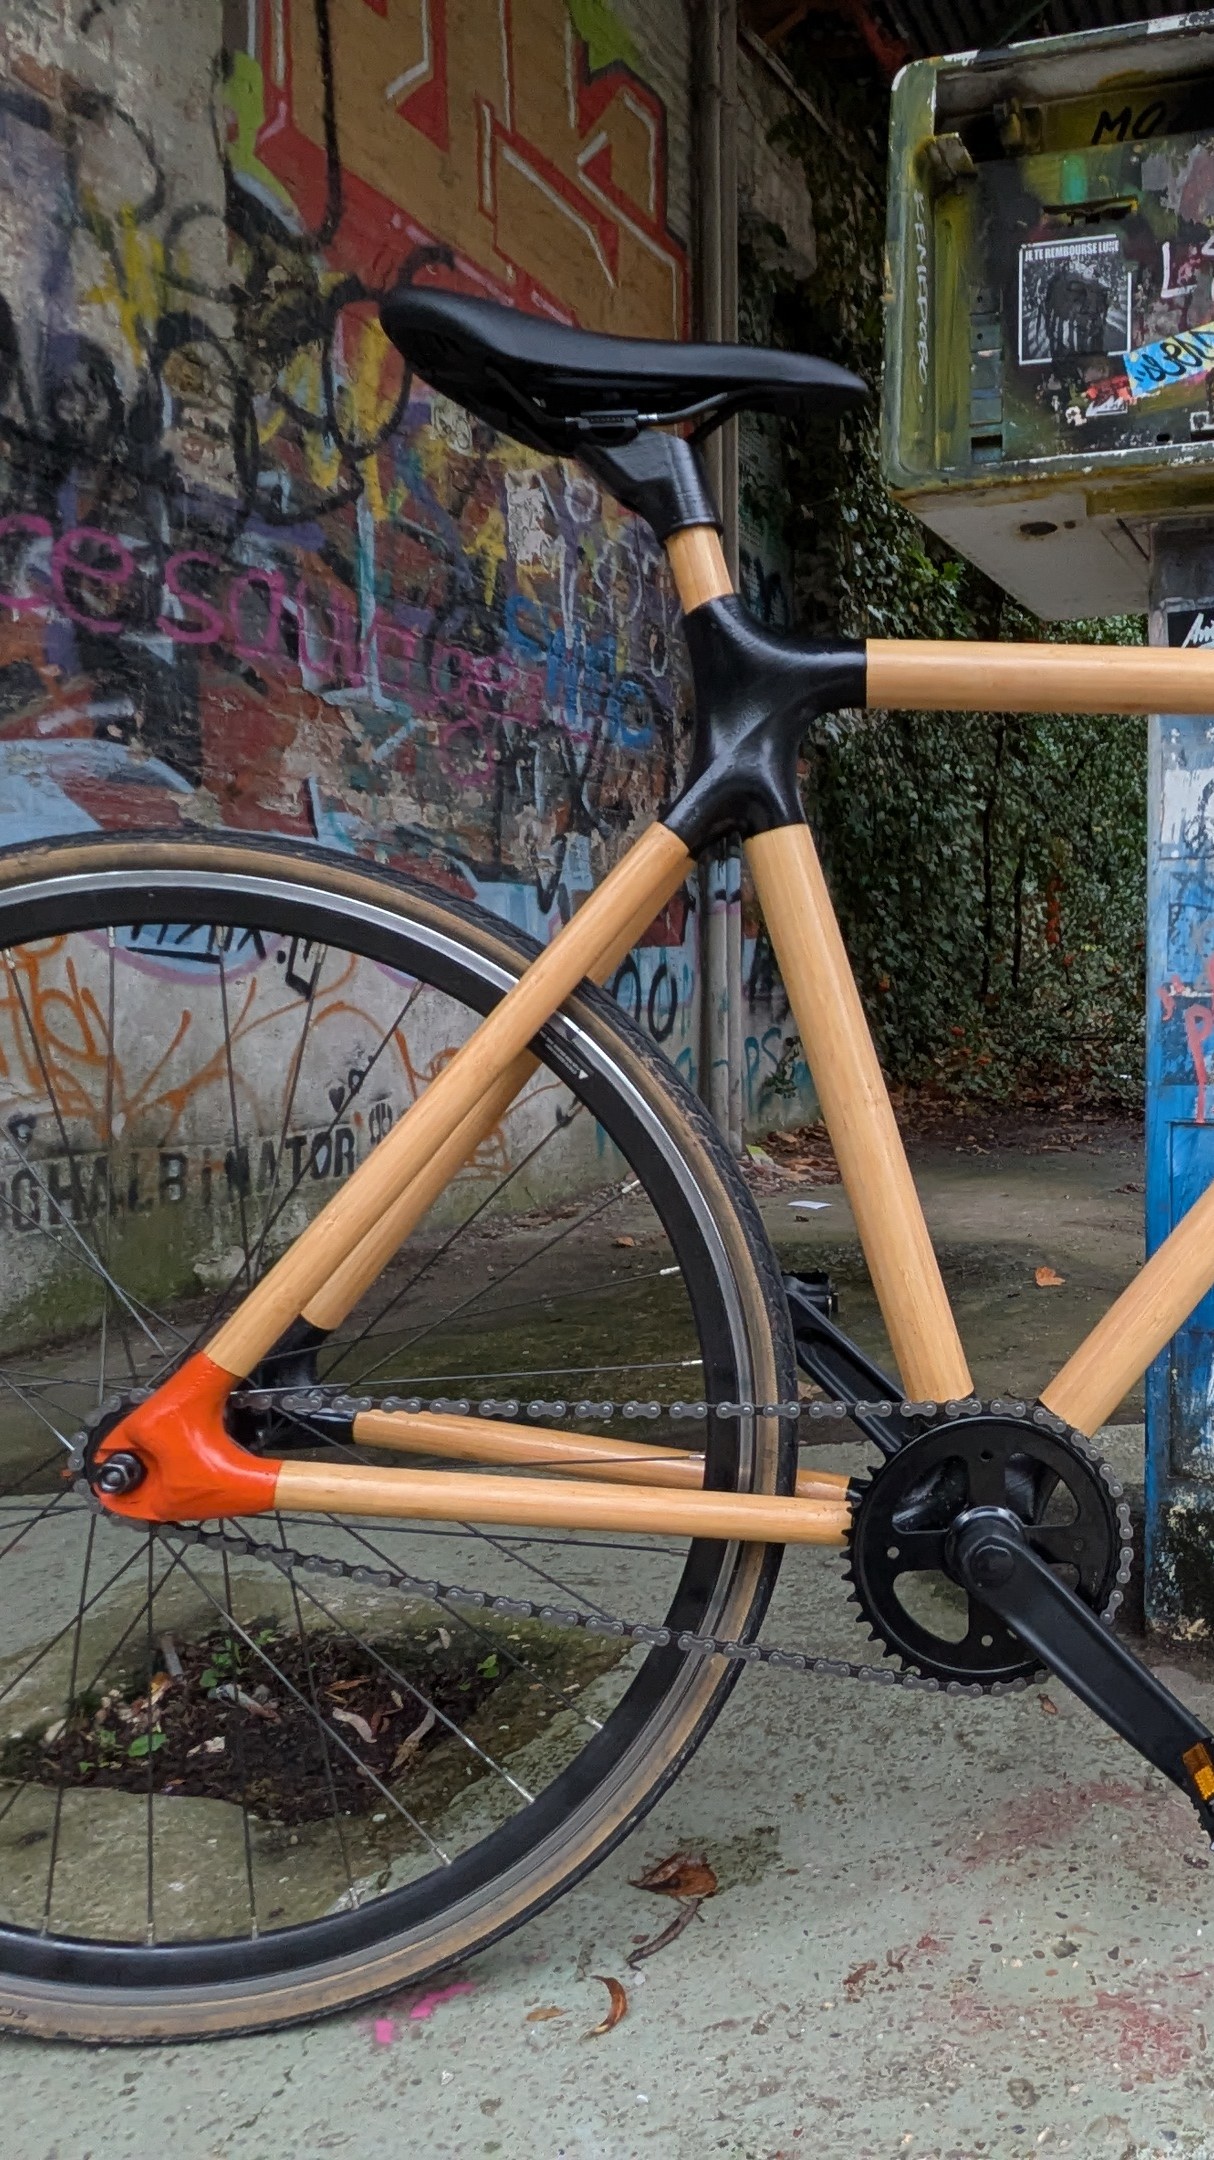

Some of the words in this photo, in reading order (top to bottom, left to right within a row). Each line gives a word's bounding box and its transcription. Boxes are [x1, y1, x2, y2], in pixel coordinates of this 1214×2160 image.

[1025, 250, 1034, 262] JE
[1034, 248, 1044, 260] TE
[1044, 243, 1098, 258] REMBOURSE
